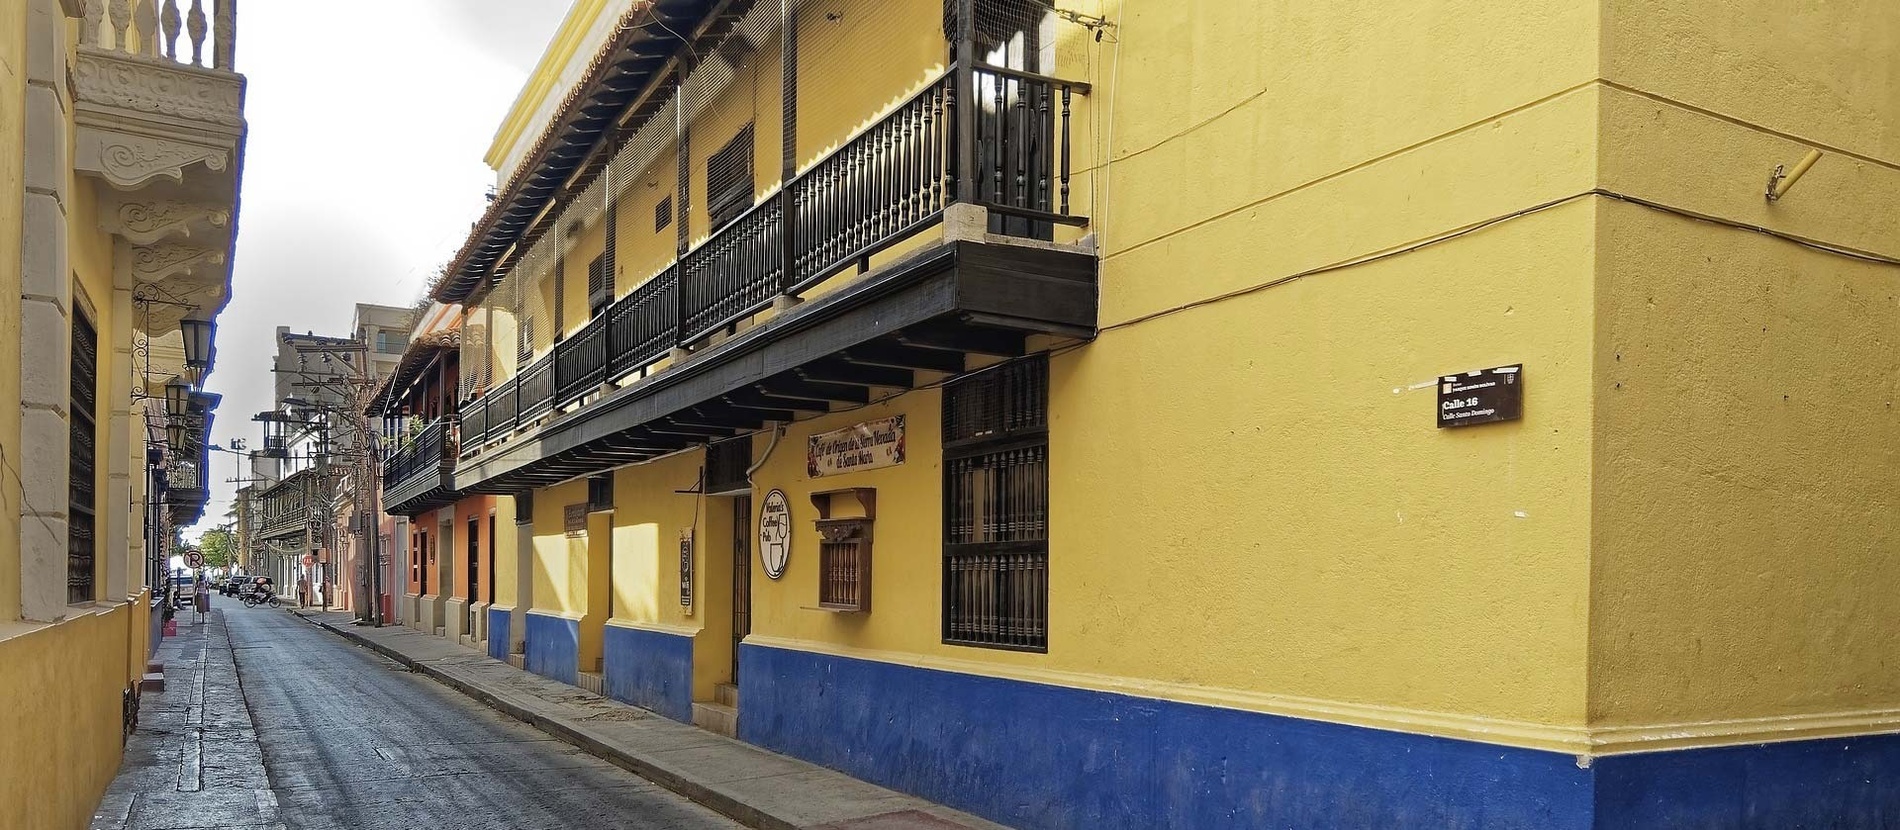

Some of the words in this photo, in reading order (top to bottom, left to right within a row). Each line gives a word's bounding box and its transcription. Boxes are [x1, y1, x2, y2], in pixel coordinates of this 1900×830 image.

[1443, 399, 1465, 410] Calle
[1466, 397, 1478, 406] 16
[1471, 408, 1495, 416] Domingo
[762, 516, 778, 528] Coffee
[762, 530, 771, 542] Pub
